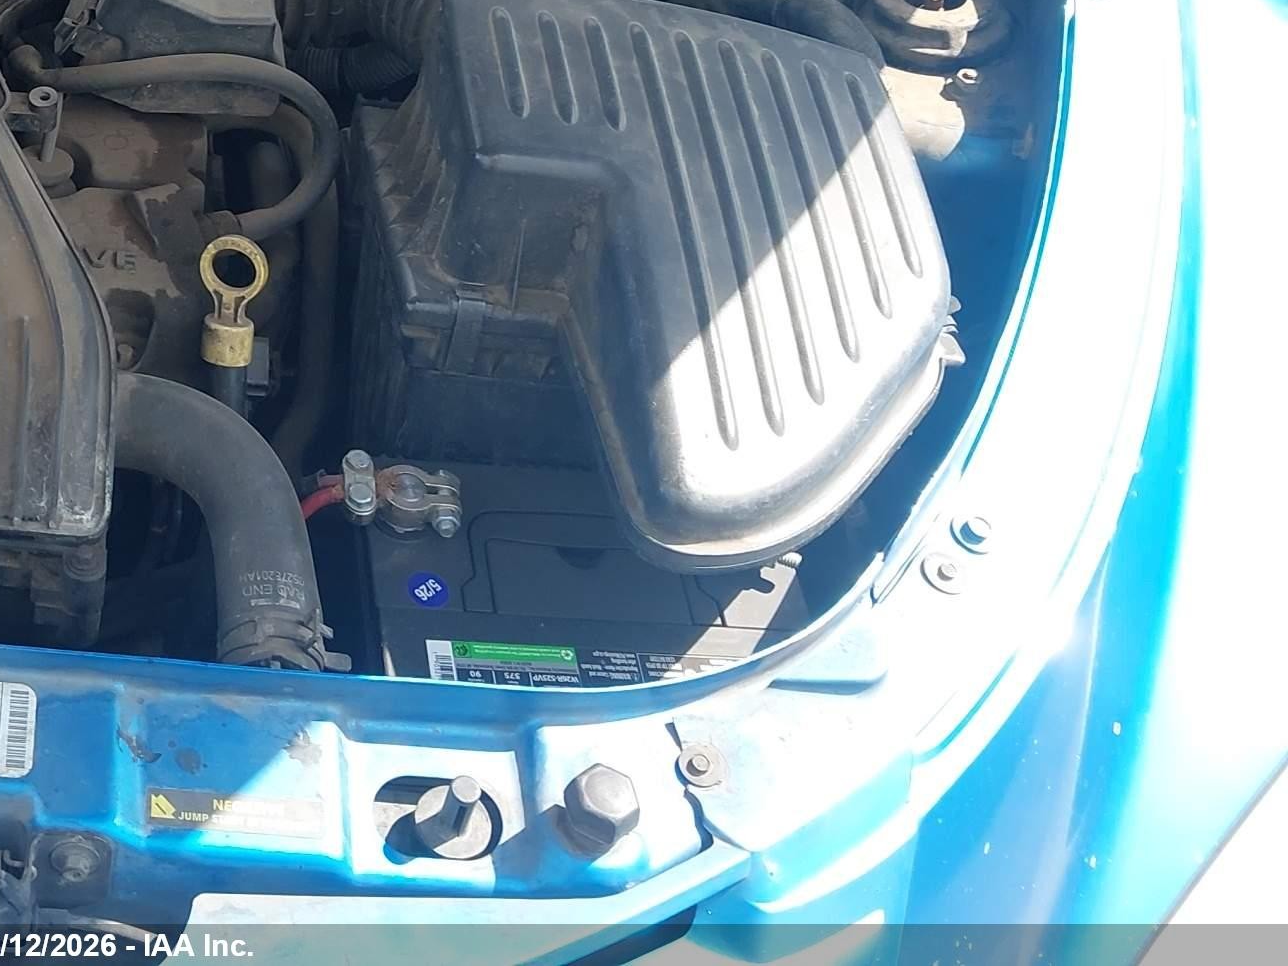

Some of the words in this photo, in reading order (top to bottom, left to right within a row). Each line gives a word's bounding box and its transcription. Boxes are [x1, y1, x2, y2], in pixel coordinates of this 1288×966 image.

[414, 578, 443, 601] 5/26
[469, 670, 482, 678] 90
[178, 811, 209, 823] JUMP
